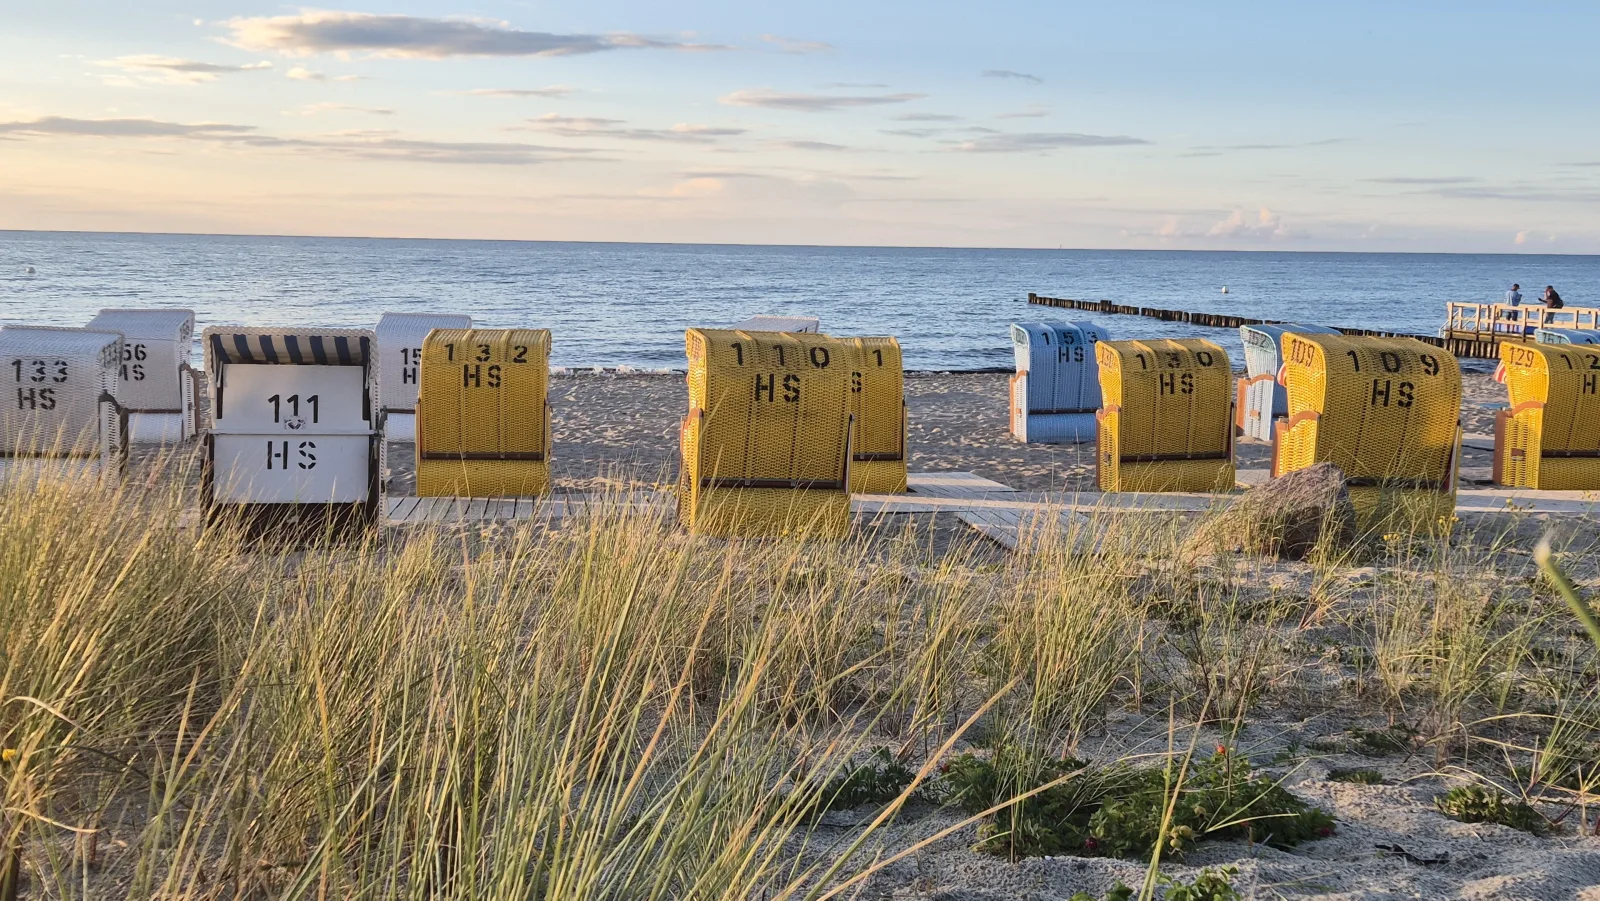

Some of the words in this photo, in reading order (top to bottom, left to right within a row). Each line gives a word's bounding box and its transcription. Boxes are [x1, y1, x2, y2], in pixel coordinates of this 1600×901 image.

[1041, 331, 1098, 345] 153
[123, 343, 147, 361] 56
[400, 347, 422, 365] 15
[444, 343, 528, 364] 132
[731, 342, 829, 369] 110
[1058, 345, 1084, 363] HS
[1135, 351, 1213, 369] 130
[1291, 339, 1315, 367] 109
[1346, 350, 1440, 376] 109
[1509, 346, 1534, 368] 129
[1560, 354, 1600, 370] 12
[11, 359, 68, 382] 133
[403, 367, 416, 384] H
[463, 364, 501, 388] HS
[755, 373, 800, 403] HS
[1160, 372, 1194, 395] HS
[1371, 378, 1415, 408] HS
[1582, 374, 1596, 394] H
[17, 387, 56, 410] HS
[267, 394, 319, 424] 111
[267, 441, 317, 470] HS
